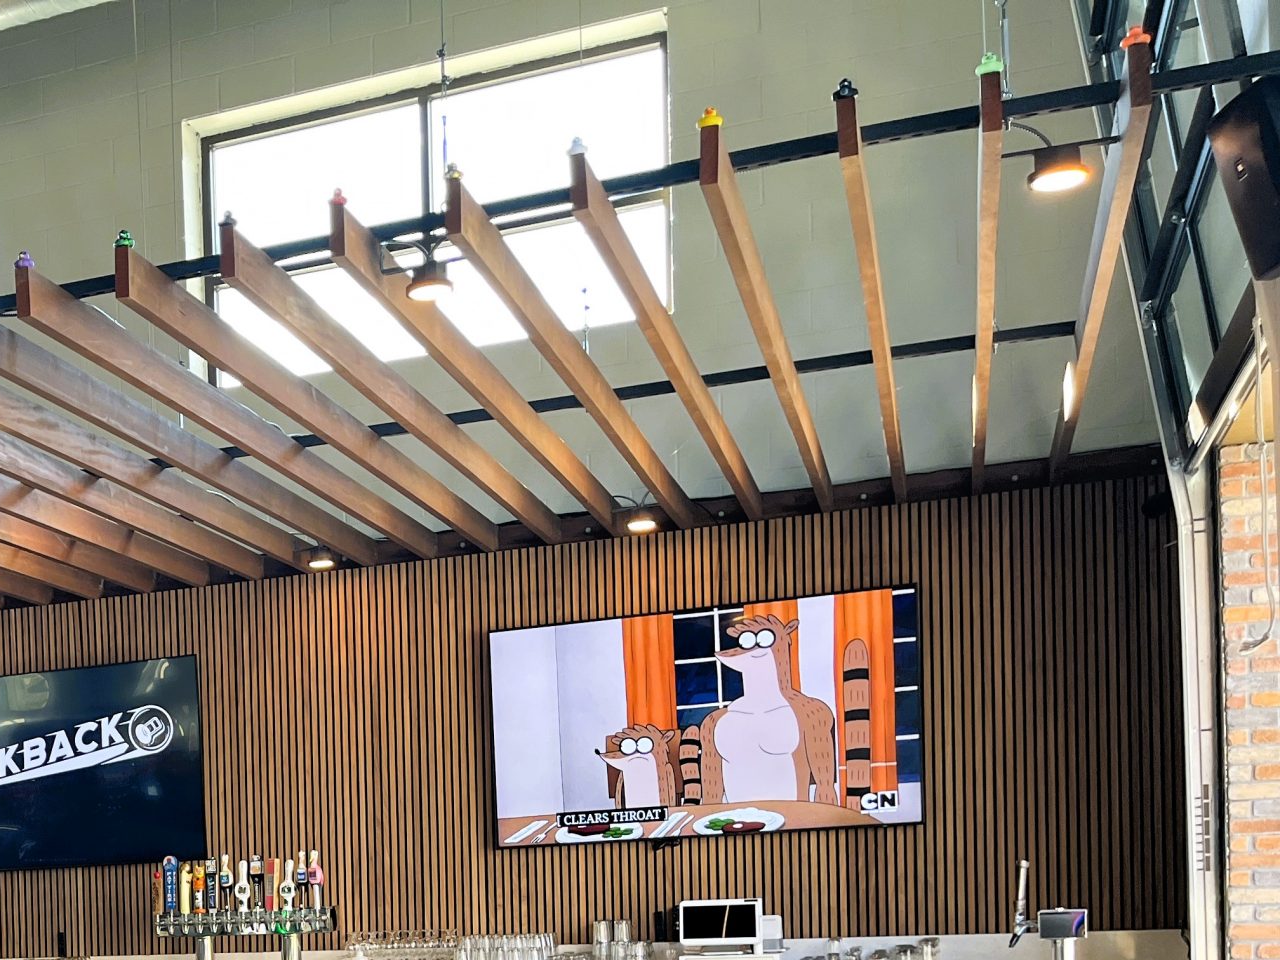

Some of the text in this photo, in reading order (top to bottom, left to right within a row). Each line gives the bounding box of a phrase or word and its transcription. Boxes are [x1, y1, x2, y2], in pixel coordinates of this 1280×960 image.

[861, 791, 897, 810] CN
[563, 812, 609, 825] CLEARS
[611, 809, 661, 822] THROAT
